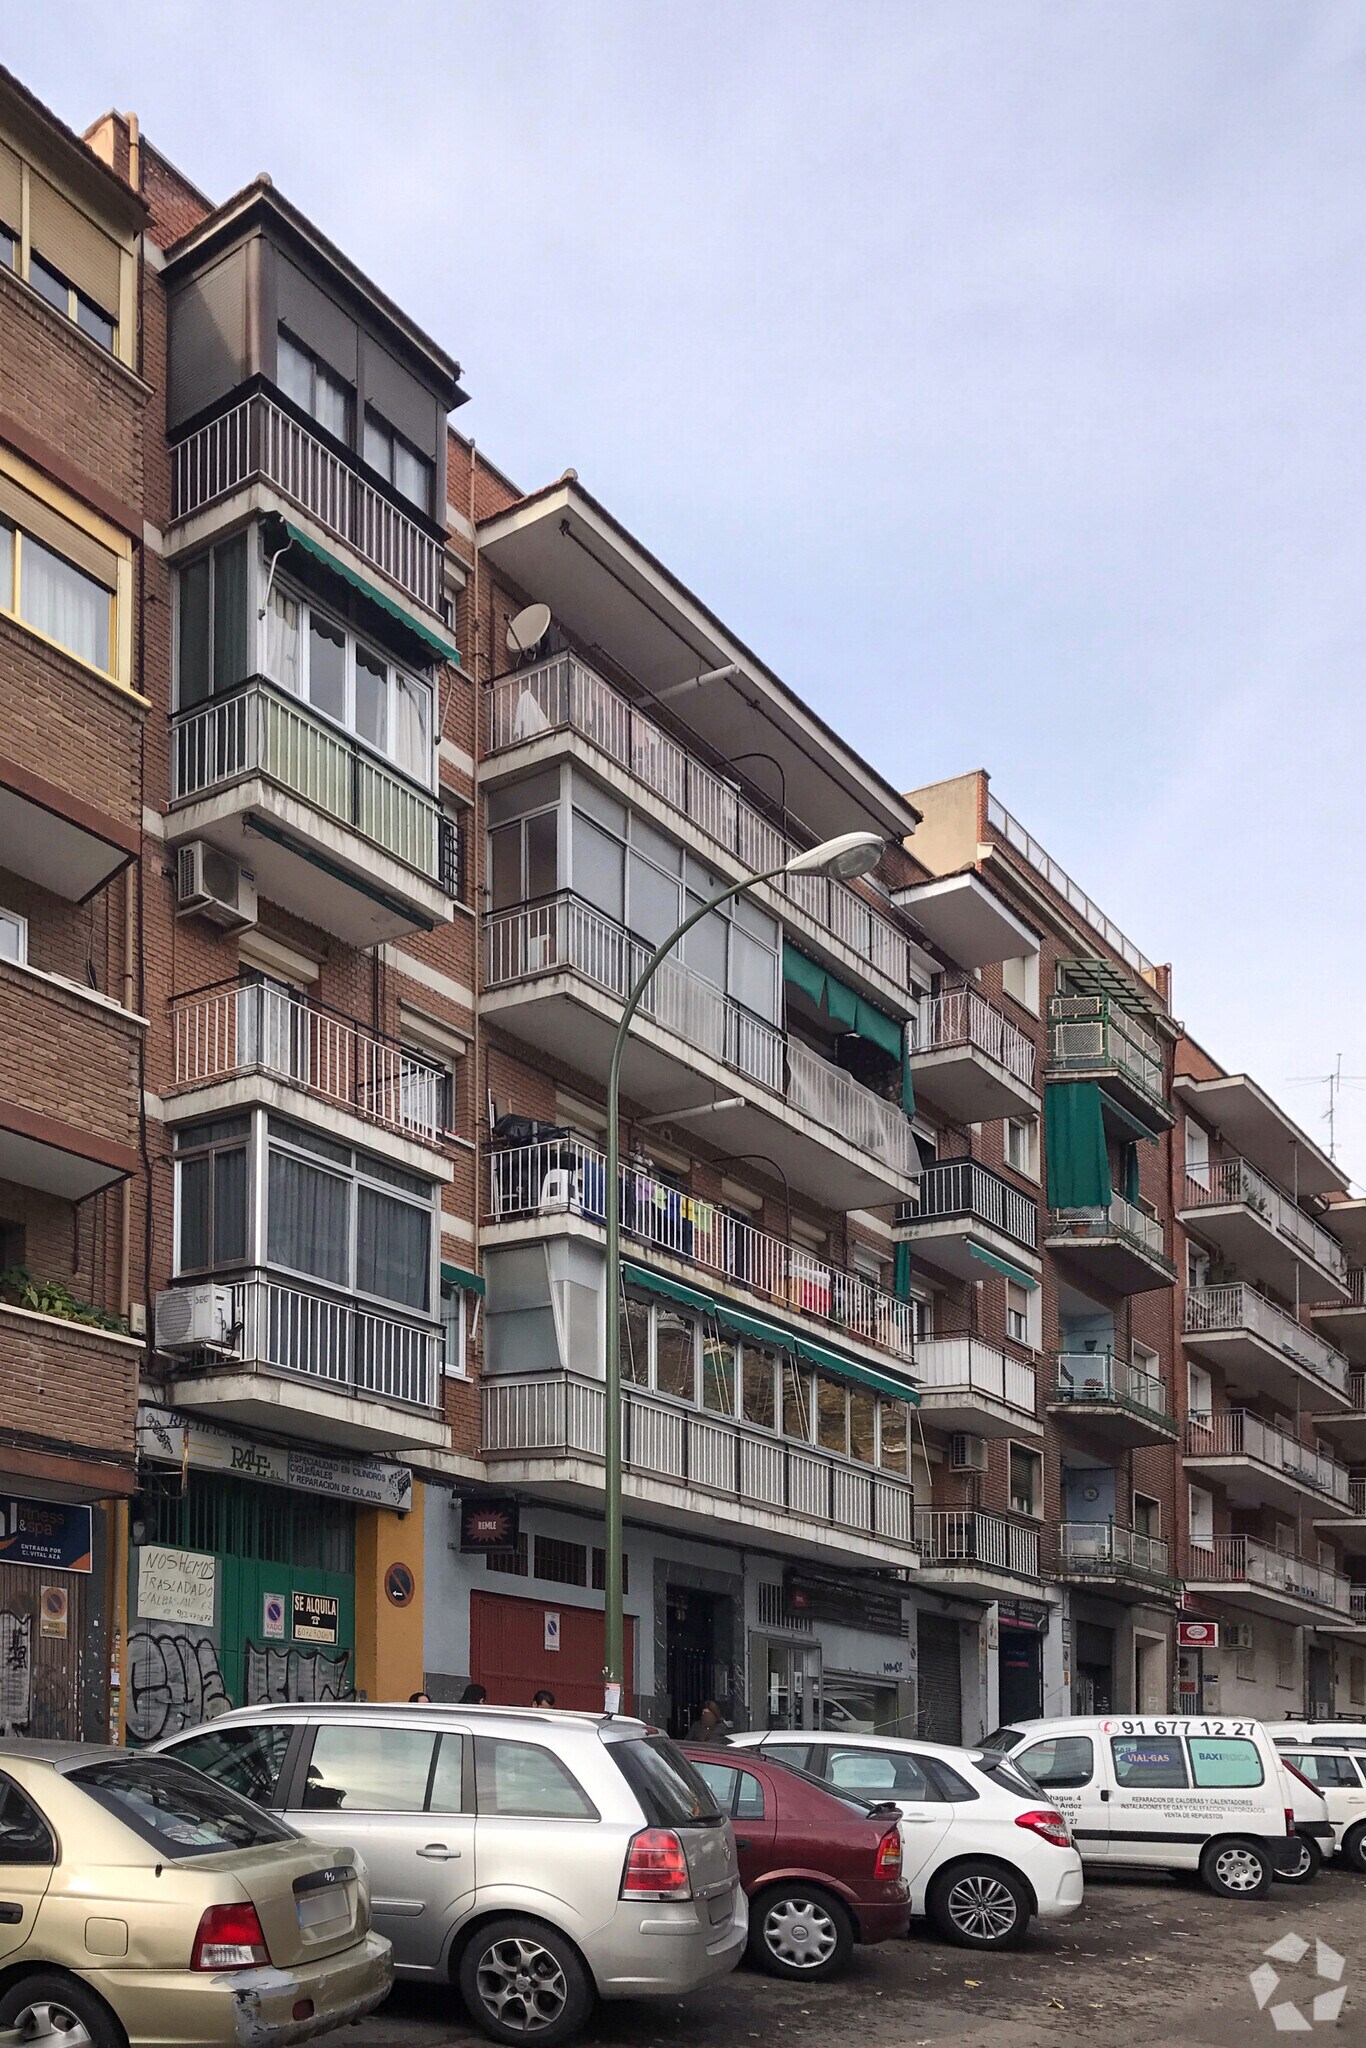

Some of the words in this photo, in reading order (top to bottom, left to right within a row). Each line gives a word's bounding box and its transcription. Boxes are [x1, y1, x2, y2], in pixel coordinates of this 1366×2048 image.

[289, 1453, 339, 1472] ESPECIALIDAD
[341, 1465, 350, 1474] EN
[352, 1468, 386, 1482] CILINDROS
[290, 1473, 295, 1481] Y
[296, 1475, 340, 1492] REPARACION
[341, 1484, 351, 1493] DE
[352, 1486, 382, 1500] CULATAS
[477, 1521, 497, 1530] REMLE
[21, 1543, 49, 1552] ENTRADA
[30, 1550, 47, 1558] VITAL
[145, 1552, 178, 1570] NOS
[178, 1553, 216, 1579] HEMOS
[142, 1570, 213, 1598] TRASLADADO
[294, 1595, 304, 1612] SE
[306, 1596, 337, 1616] ALQUILA
[265, 1622, 283, 1631] VADO
[1121, 1720, 1146, 1735] 91
[1154, 1720, 1191, 1735] 677
[1201, 1721, 1226, 1736] 12
[1232, 1722, 1256, 1736] 27
[1127, 1753, 1170, 1762] VIAL-GAS
[1210, 1798, 1253, 1806] CALENTADORES
